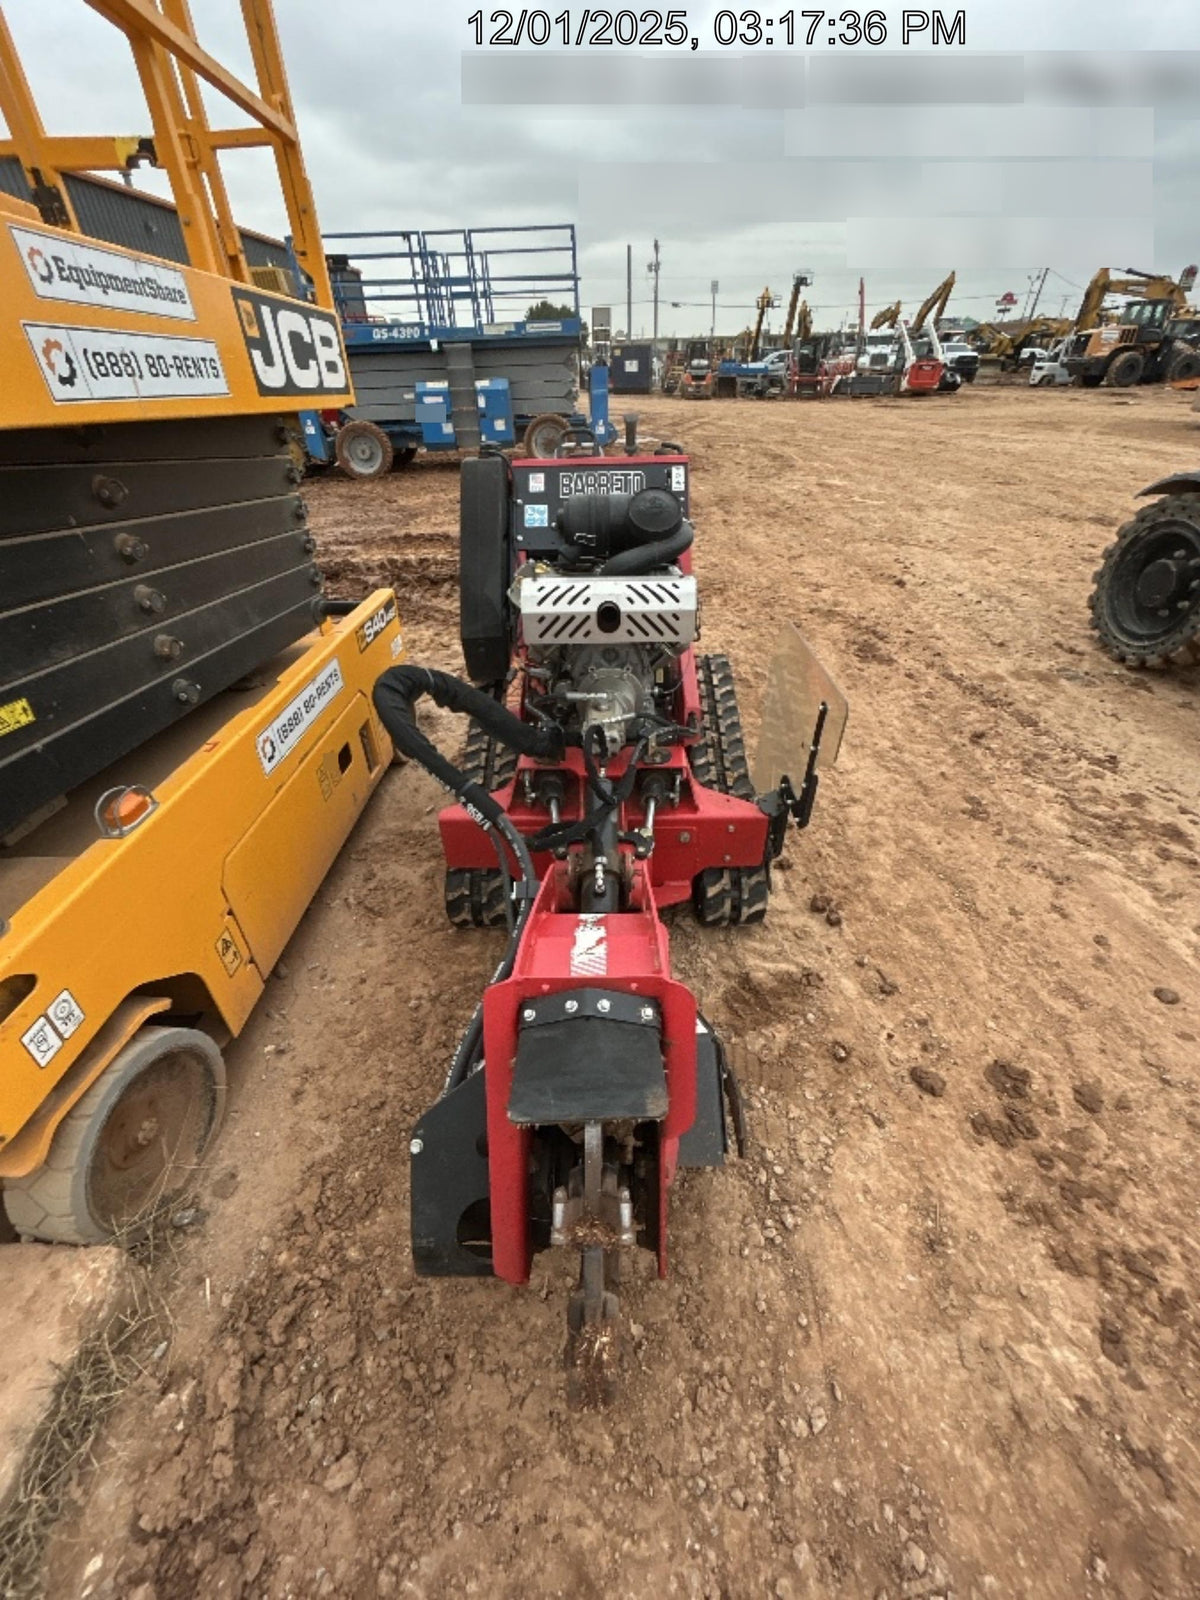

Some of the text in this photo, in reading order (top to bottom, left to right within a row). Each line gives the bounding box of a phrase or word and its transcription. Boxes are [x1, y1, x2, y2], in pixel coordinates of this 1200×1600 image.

[51, 254, 188, 305] EquipmentShare
[82, 347, 220, 381] (888) 80-RENTS
[250, 304, 347, 389] JCB
[559, 470, 647, 499] BARRETO
